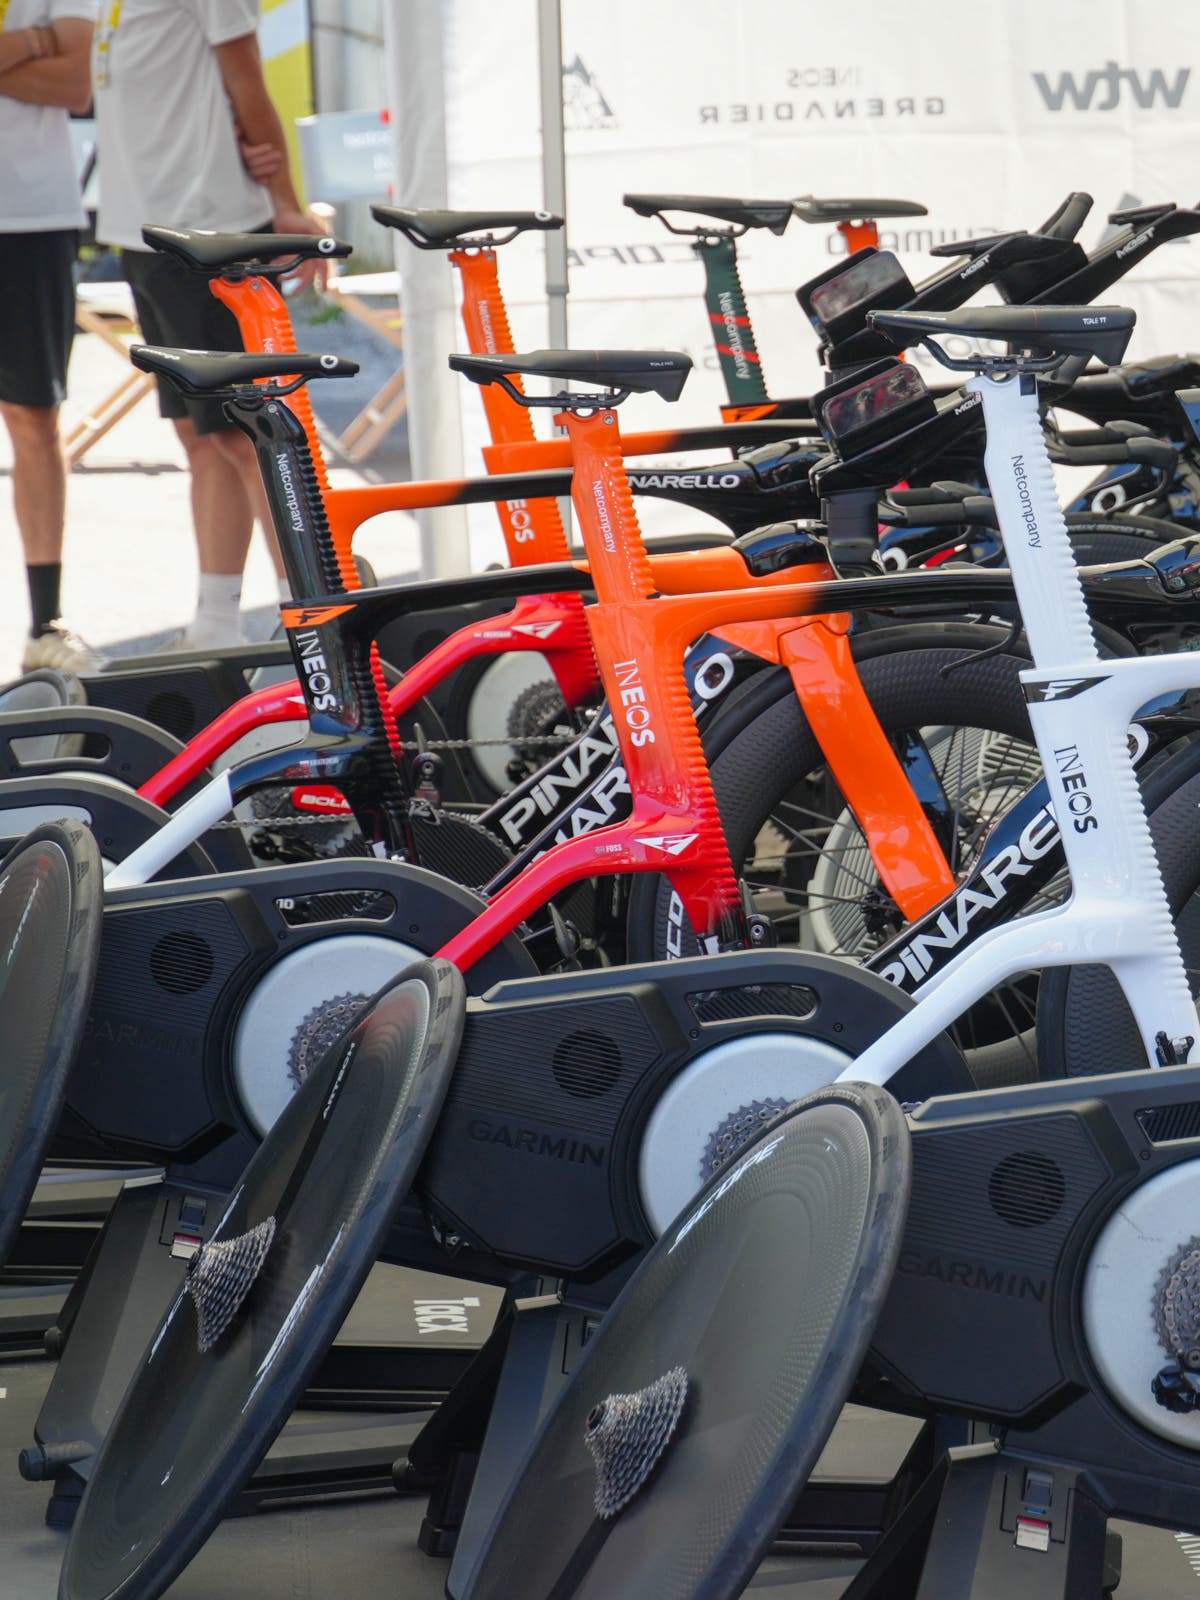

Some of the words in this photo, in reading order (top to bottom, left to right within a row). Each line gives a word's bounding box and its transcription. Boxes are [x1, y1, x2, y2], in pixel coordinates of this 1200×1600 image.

[275, 452, 305, 532] Netcompany
[591, 480, 617, 554] Netcompany
[628, 474, 741, 489] NARELLO
[1011, 454, 1042, 550] Netcompany
[506, 499, 536, 543] EOS
[296, 630, 336, 711] INEOS
[614, 659, 655, 747] INEOS
[1054, 744, 1098, 834] INEOS
[465, 1118, 605, 1168] GARMIN
[897, 1249, 1047, 1303] GARMIN
[413, 1297, 480, 1334] Tacx
